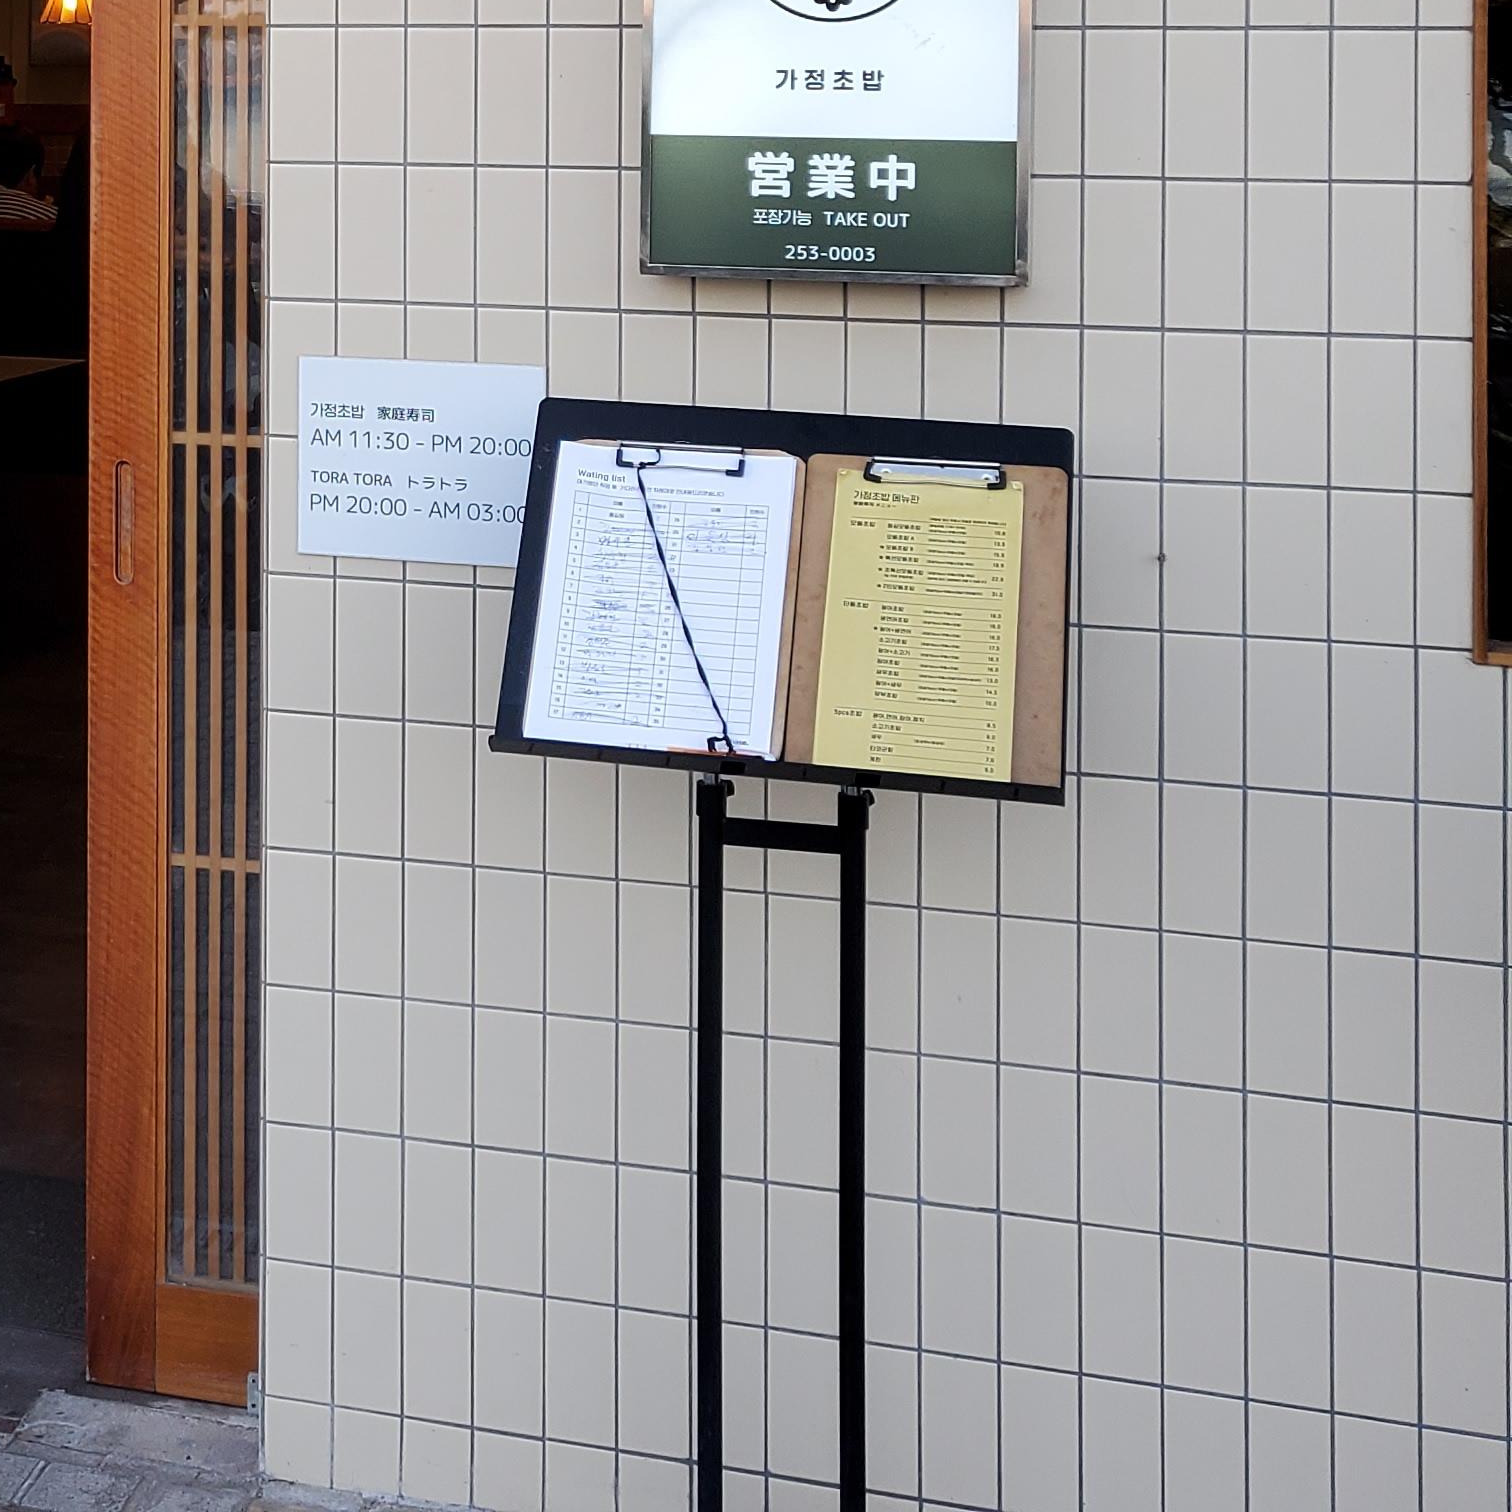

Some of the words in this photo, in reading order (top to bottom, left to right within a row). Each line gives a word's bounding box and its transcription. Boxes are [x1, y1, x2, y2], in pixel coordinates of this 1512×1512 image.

[775, 69, 885, 92] 가정초밥
[746, 151, 917, 202] 営業中
[823, 211, 868, 227] TAKE
[872, 212, 911, 228] OUT
[784, 244, 876, 263] 253-0003
[310, 402, 365, 419] 가정초밥
[376, 405, 435, 423] 家庭寿司
[310, 428, 342, 447] AM
[349, 430, 410, 451] 11:30
[432, 434, 462, 454] PM
[469, 436, 532, 457] 20:00
[310, 470, 349, 485] TORA
[353, 472, 393, 487] TORA
[407, 475, 468, 491] トラトラ
[310, 493, 339, 513] PM
[346, 495, 407, 517] 20:00
[428, 501, 460, 520] AM
